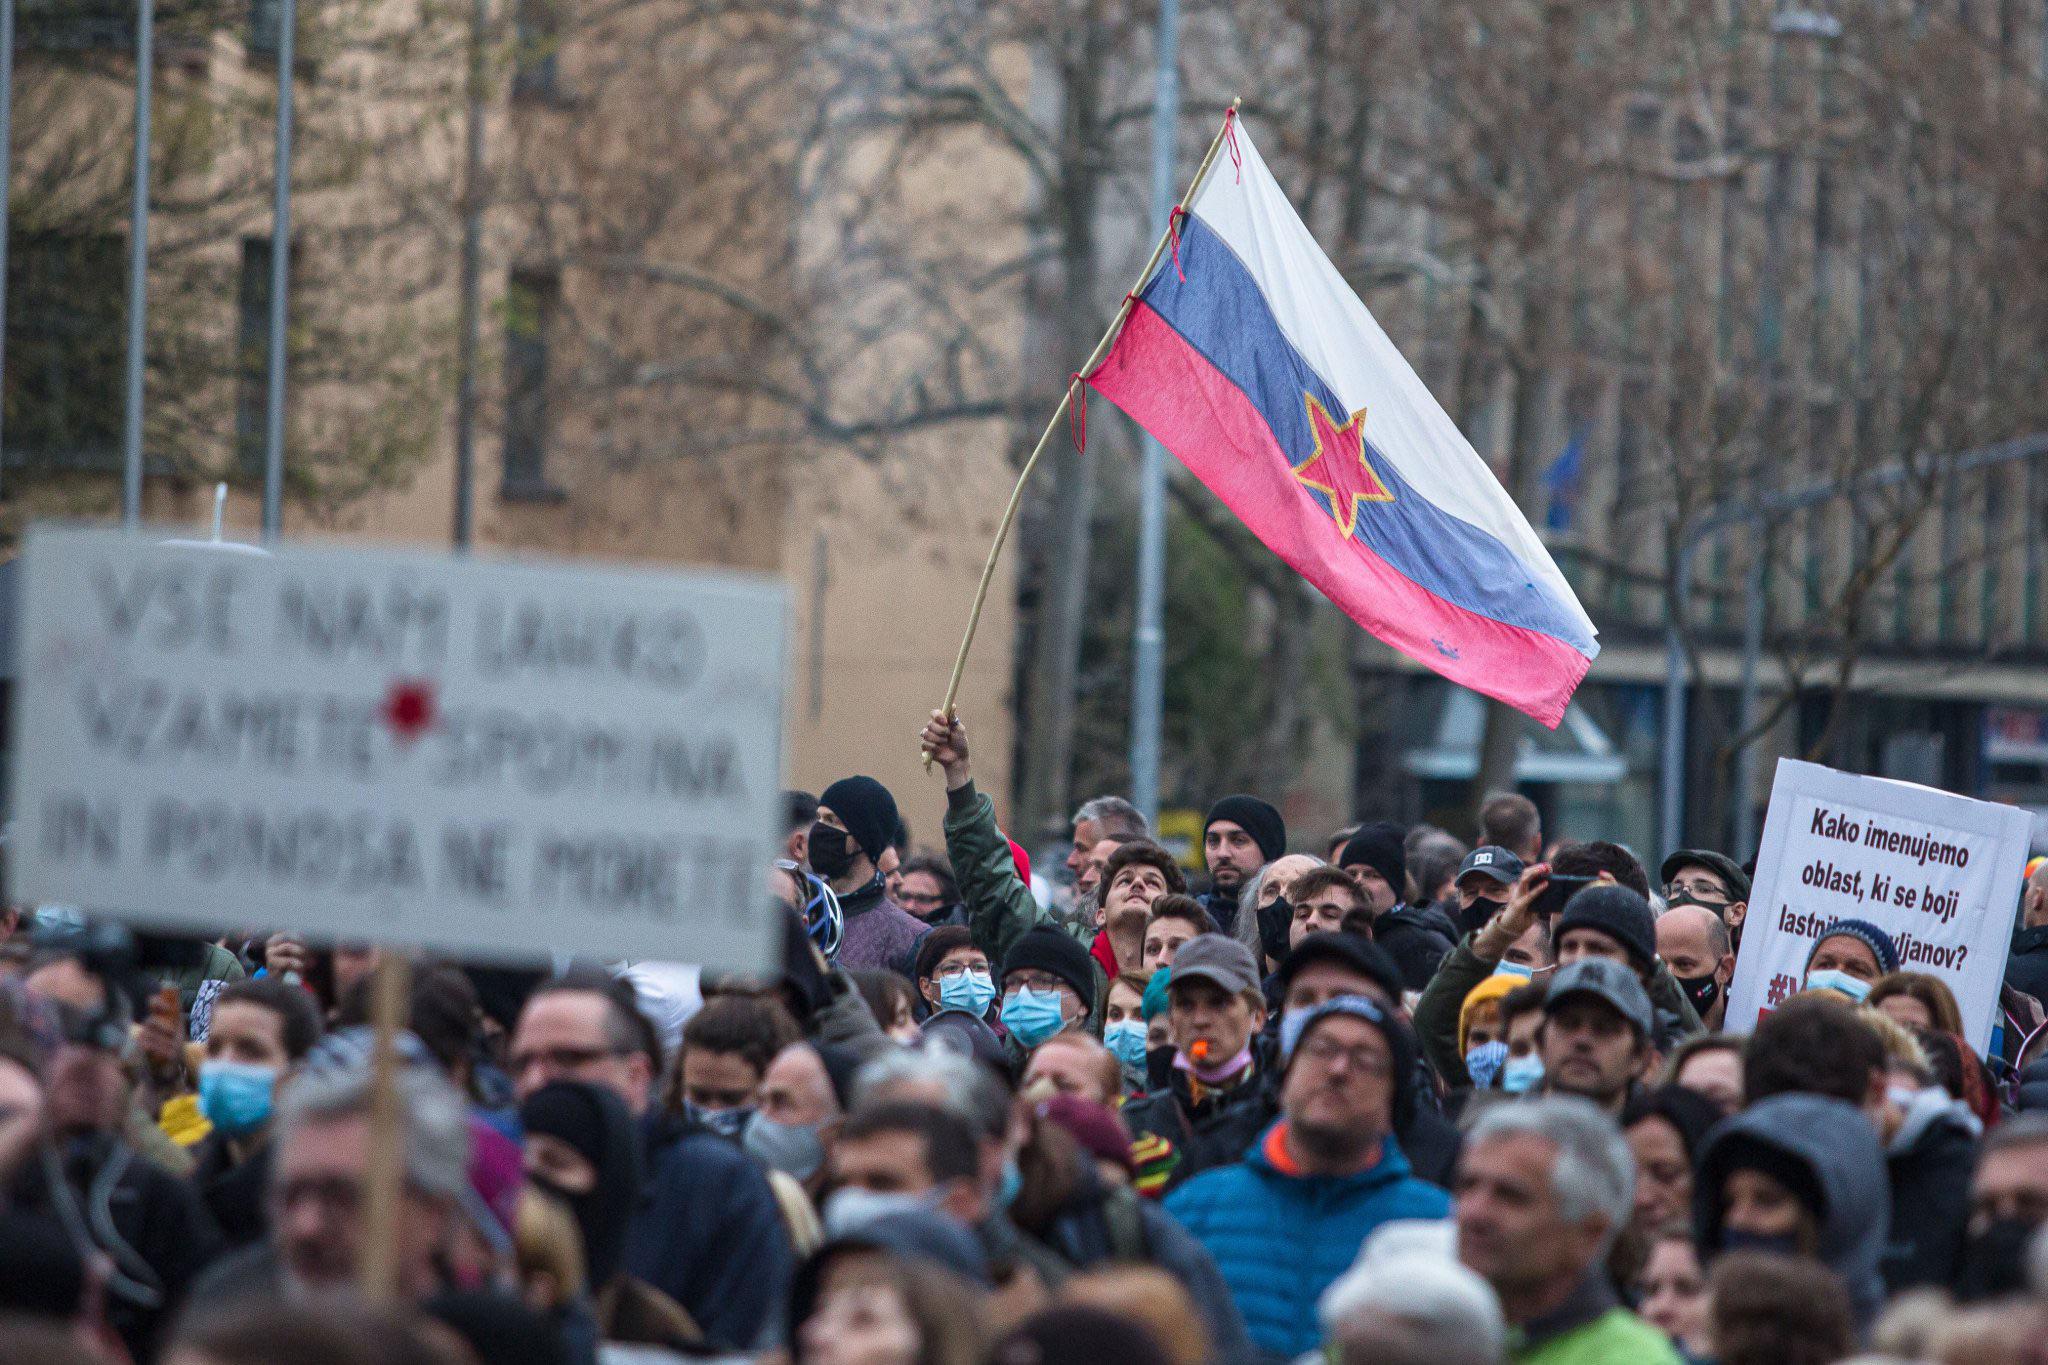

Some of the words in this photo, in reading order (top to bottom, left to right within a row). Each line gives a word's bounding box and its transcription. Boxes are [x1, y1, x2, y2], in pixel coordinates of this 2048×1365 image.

[1811, 807, 1860, 843] Kako
[1864, 819, 1969, 868] imenujemo
[1802, 859, 1864, 903] oblast,
[1870, 873, 1891, 903] ki
[1893, 885, 1917, 908] se
[1921, 885, 1960, 924] boji
